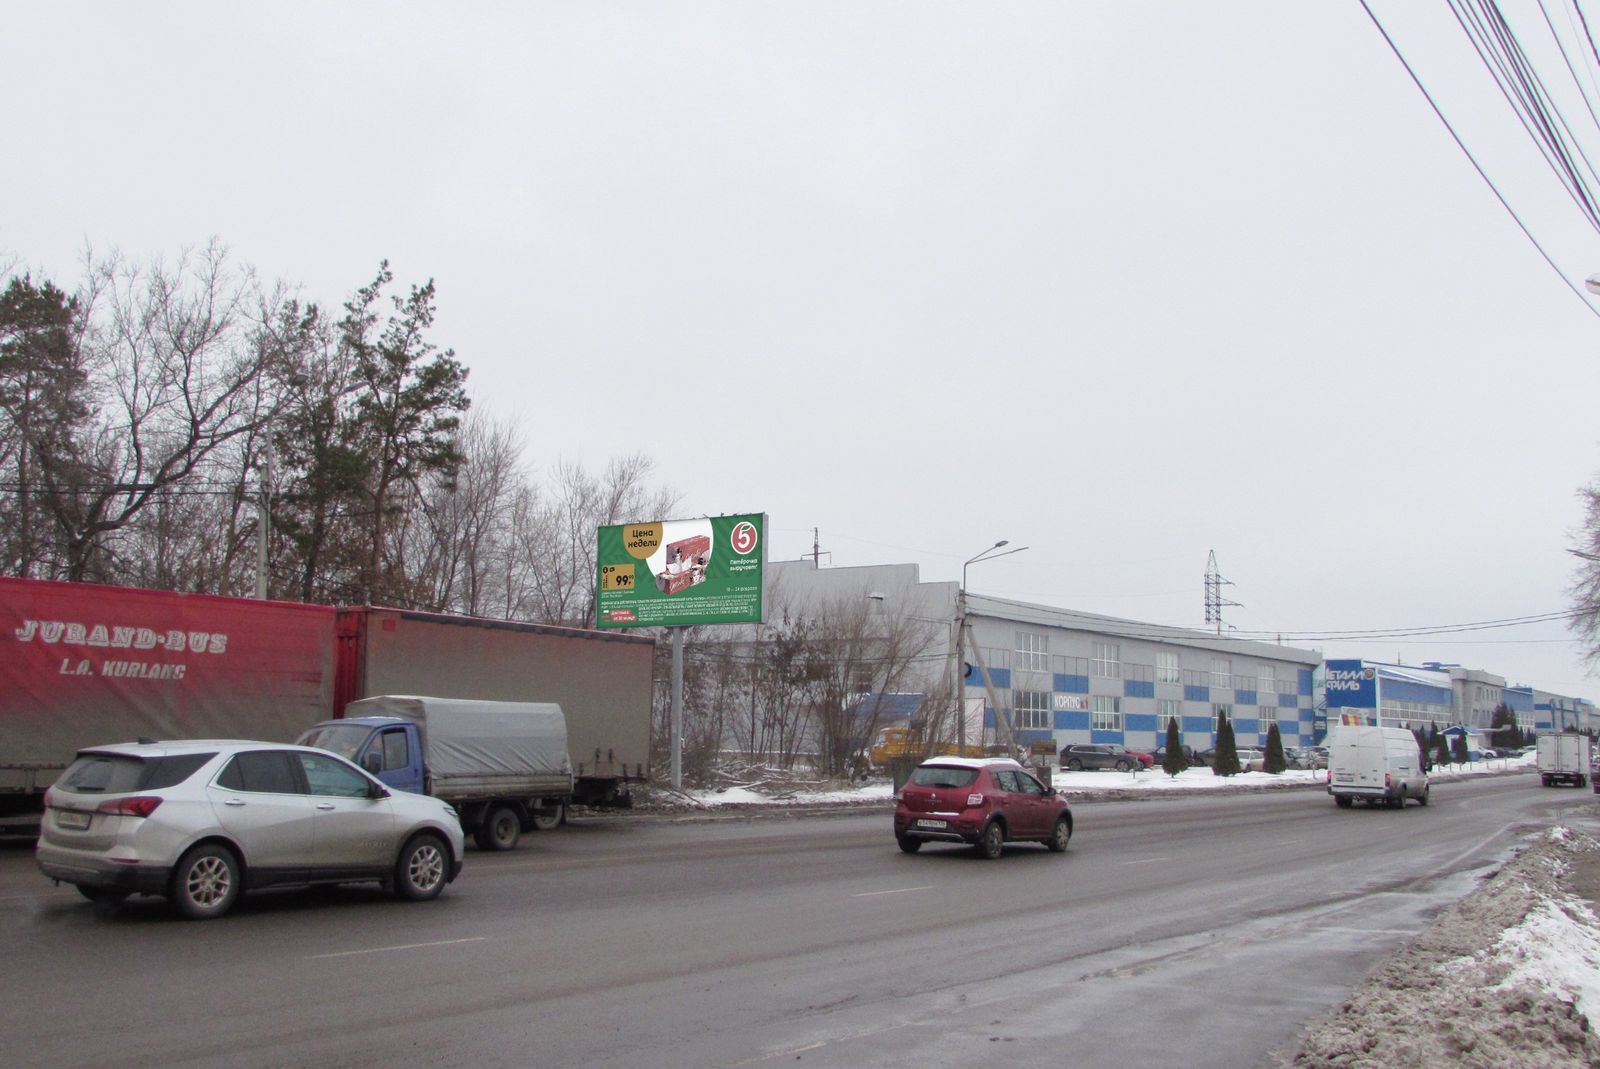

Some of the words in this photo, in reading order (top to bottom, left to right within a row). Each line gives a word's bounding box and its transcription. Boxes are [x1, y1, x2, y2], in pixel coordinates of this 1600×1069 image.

[632, 529, 654, 539] Цена
[627, 539, 658, 548] недели
[59, 658, 94, 676] L.A.
[1054, 695, 1081, 709] КОРПУС
